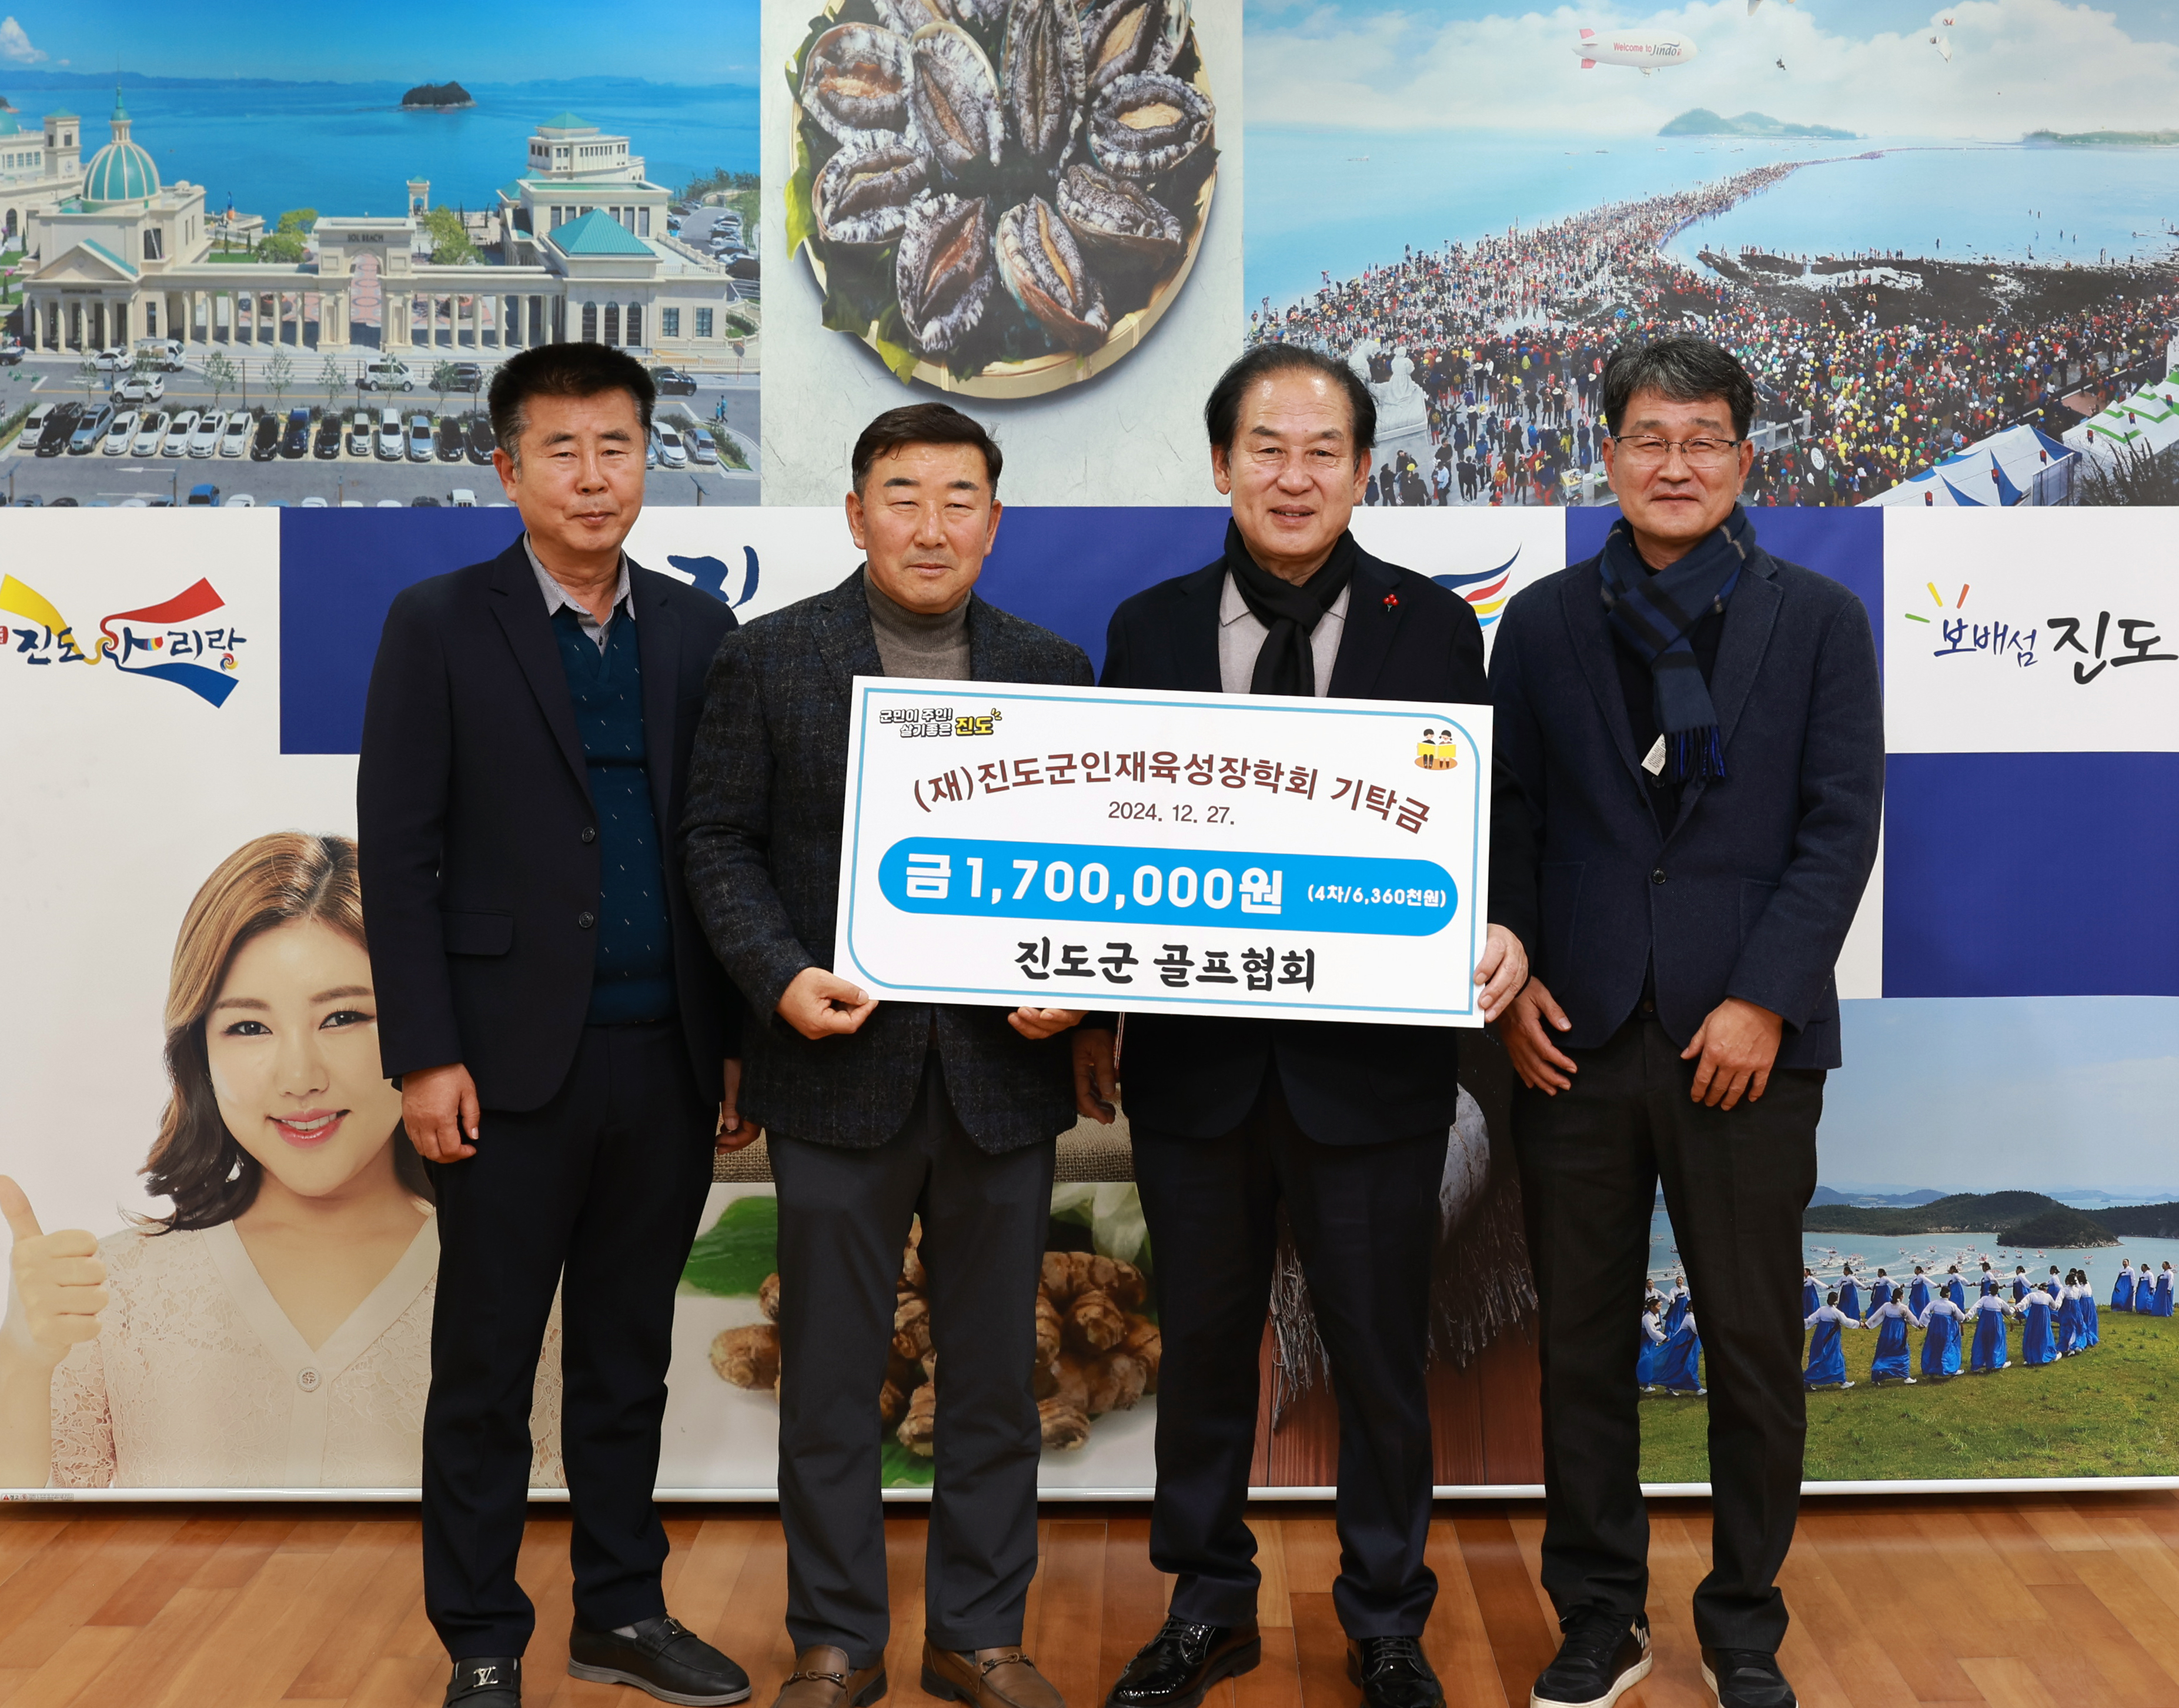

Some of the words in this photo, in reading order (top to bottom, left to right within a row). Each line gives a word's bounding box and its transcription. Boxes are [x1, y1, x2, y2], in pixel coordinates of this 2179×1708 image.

[1613, 42, 1643, 52] Welcome
[1646, 44, 1652, 52] to
[347, 233, 360, 242] SOL
[362, 233, 384, 242] BEACH
[1933, 617, 2038, 668] 보배섬
[2047, 610, 2179, 685] 진도
[880, 709, 919, 724] 군민이
[921, 708, 953, 723] 주인!
[900, 723, 953, 738] 살기좋은
[955, 716, 994, 736] 진도
[914, 751, 1318, 813] (재)진도군인재육성장학회
[1330, 777, 1431, 834] 기탁금
[1108, 801, 1162, 822] 2024.
[1172, 804, 1198, 823] 12.
[1207, 806, 1235, 825] 27.
[1308, 884, 1446, 908] (4차/6,360천원)
[1014, 936, 1139, 984] 진도군
[1153, 944, 1315, 993] 골프협회
